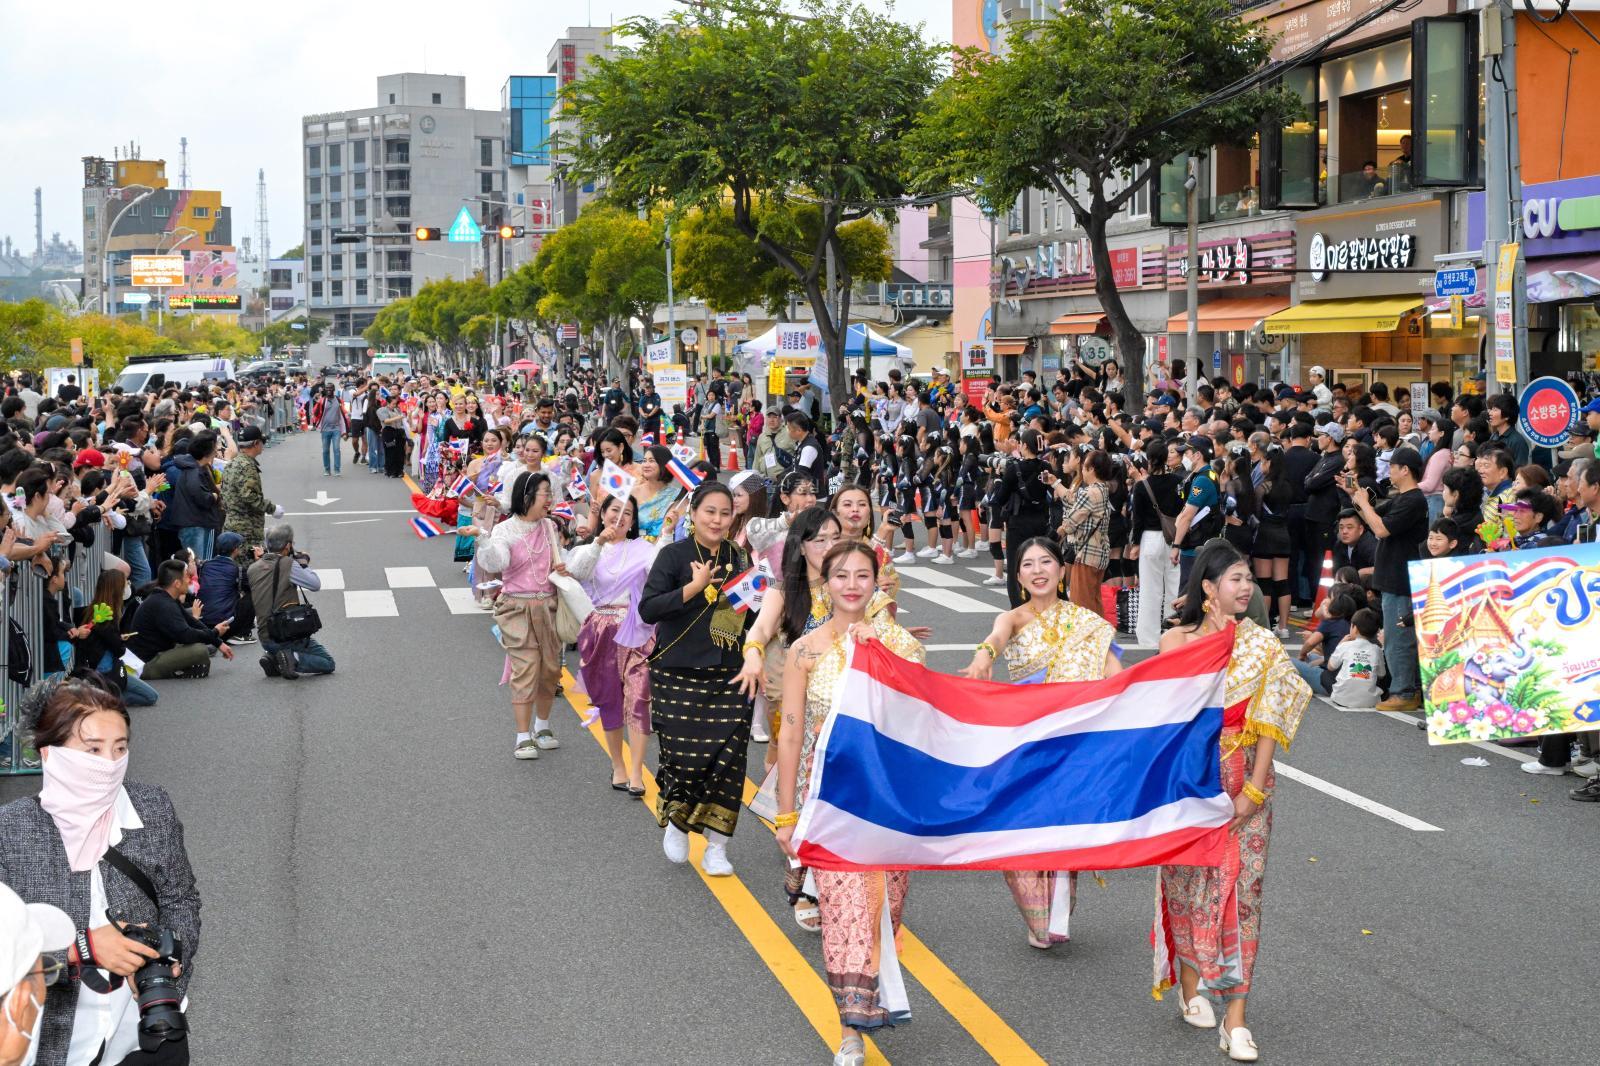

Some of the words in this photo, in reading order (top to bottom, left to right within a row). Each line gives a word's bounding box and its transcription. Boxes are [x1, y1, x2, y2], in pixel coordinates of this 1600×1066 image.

[1523, 198, 1557, 239] CU
[1443, 271, 1469, 286] 장생포고래로
[1087, 346, 1106, 360] 35
[1530, 401, 1568, 422] 소방용수
[75, 928, 91, 960] Canon
